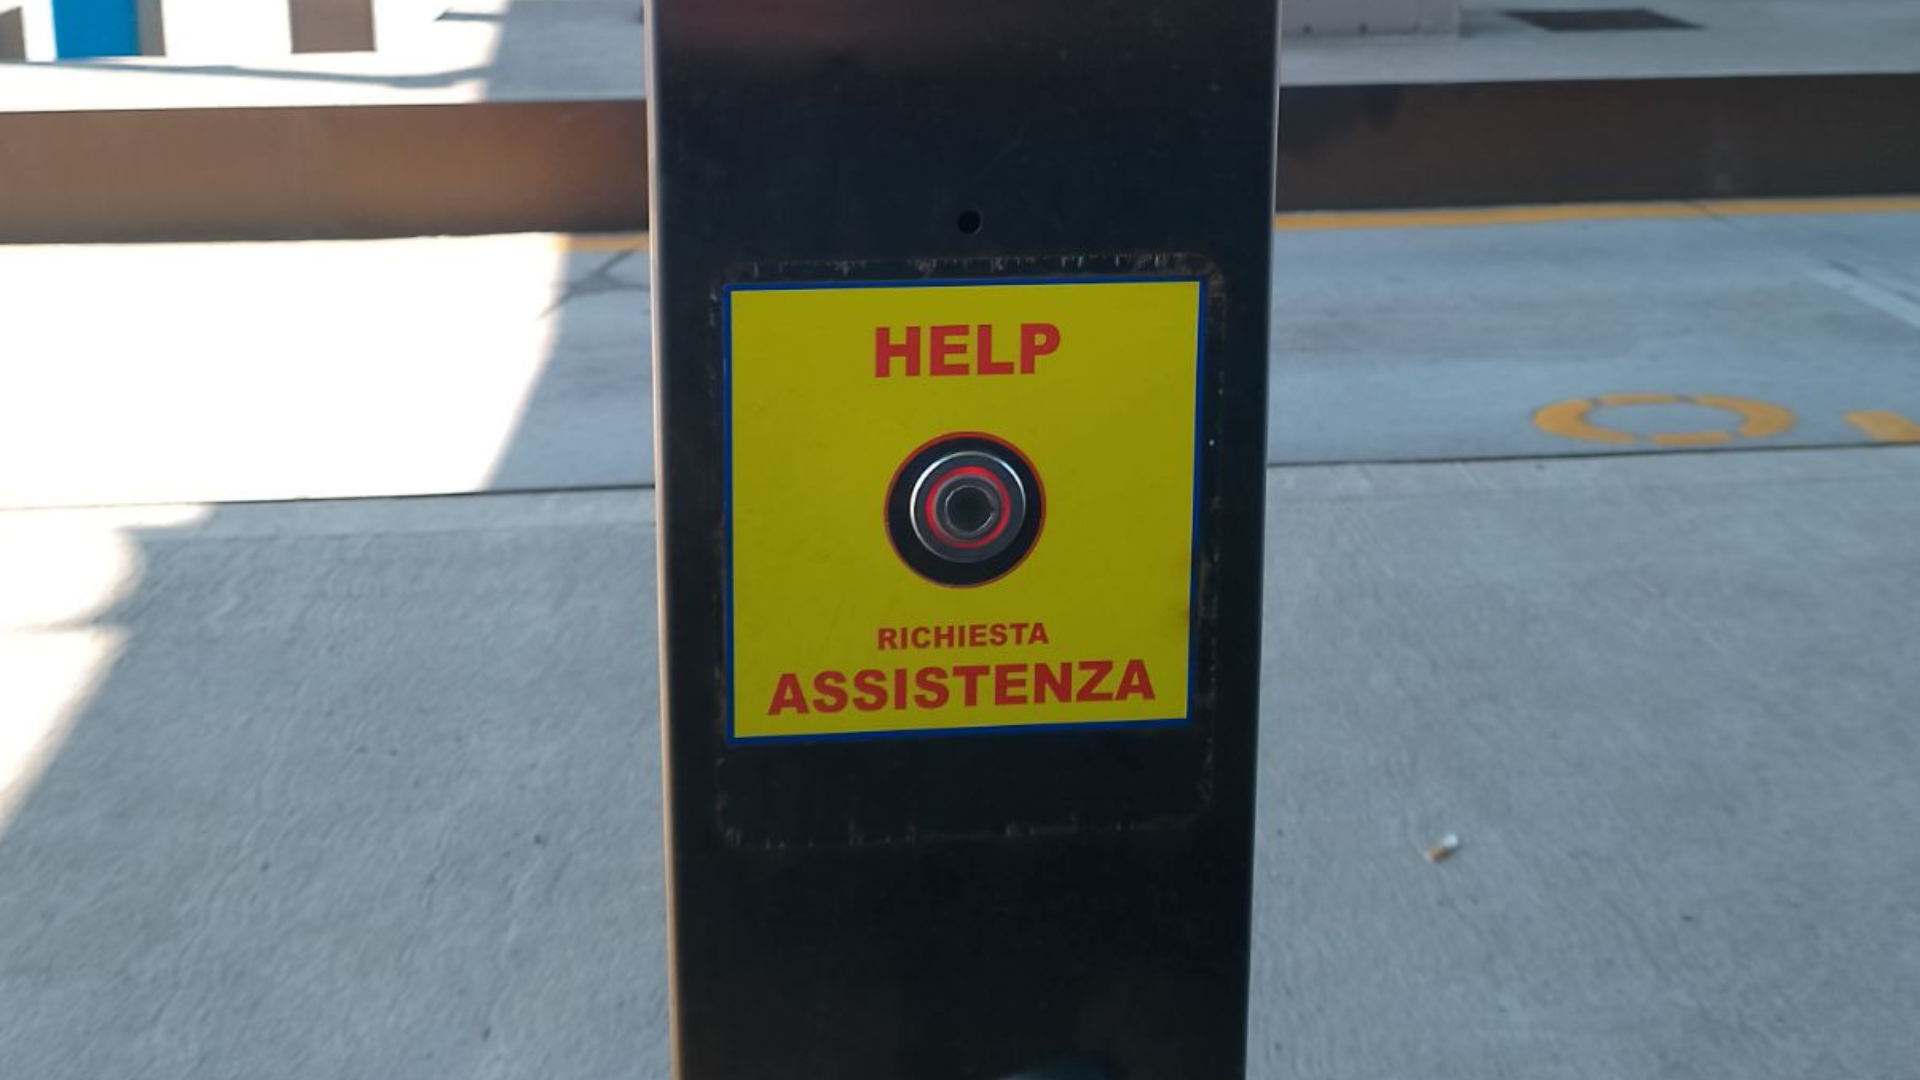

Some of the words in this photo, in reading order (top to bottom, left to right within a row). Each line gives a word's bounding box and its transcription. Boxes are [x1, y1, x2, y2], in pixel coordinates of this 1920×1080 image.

[874, 322, 1061, 378] HELP
[877, 621, 1050, 650] RICHIESTA
[768, 658, 1156, 716] ASSISTENZA
